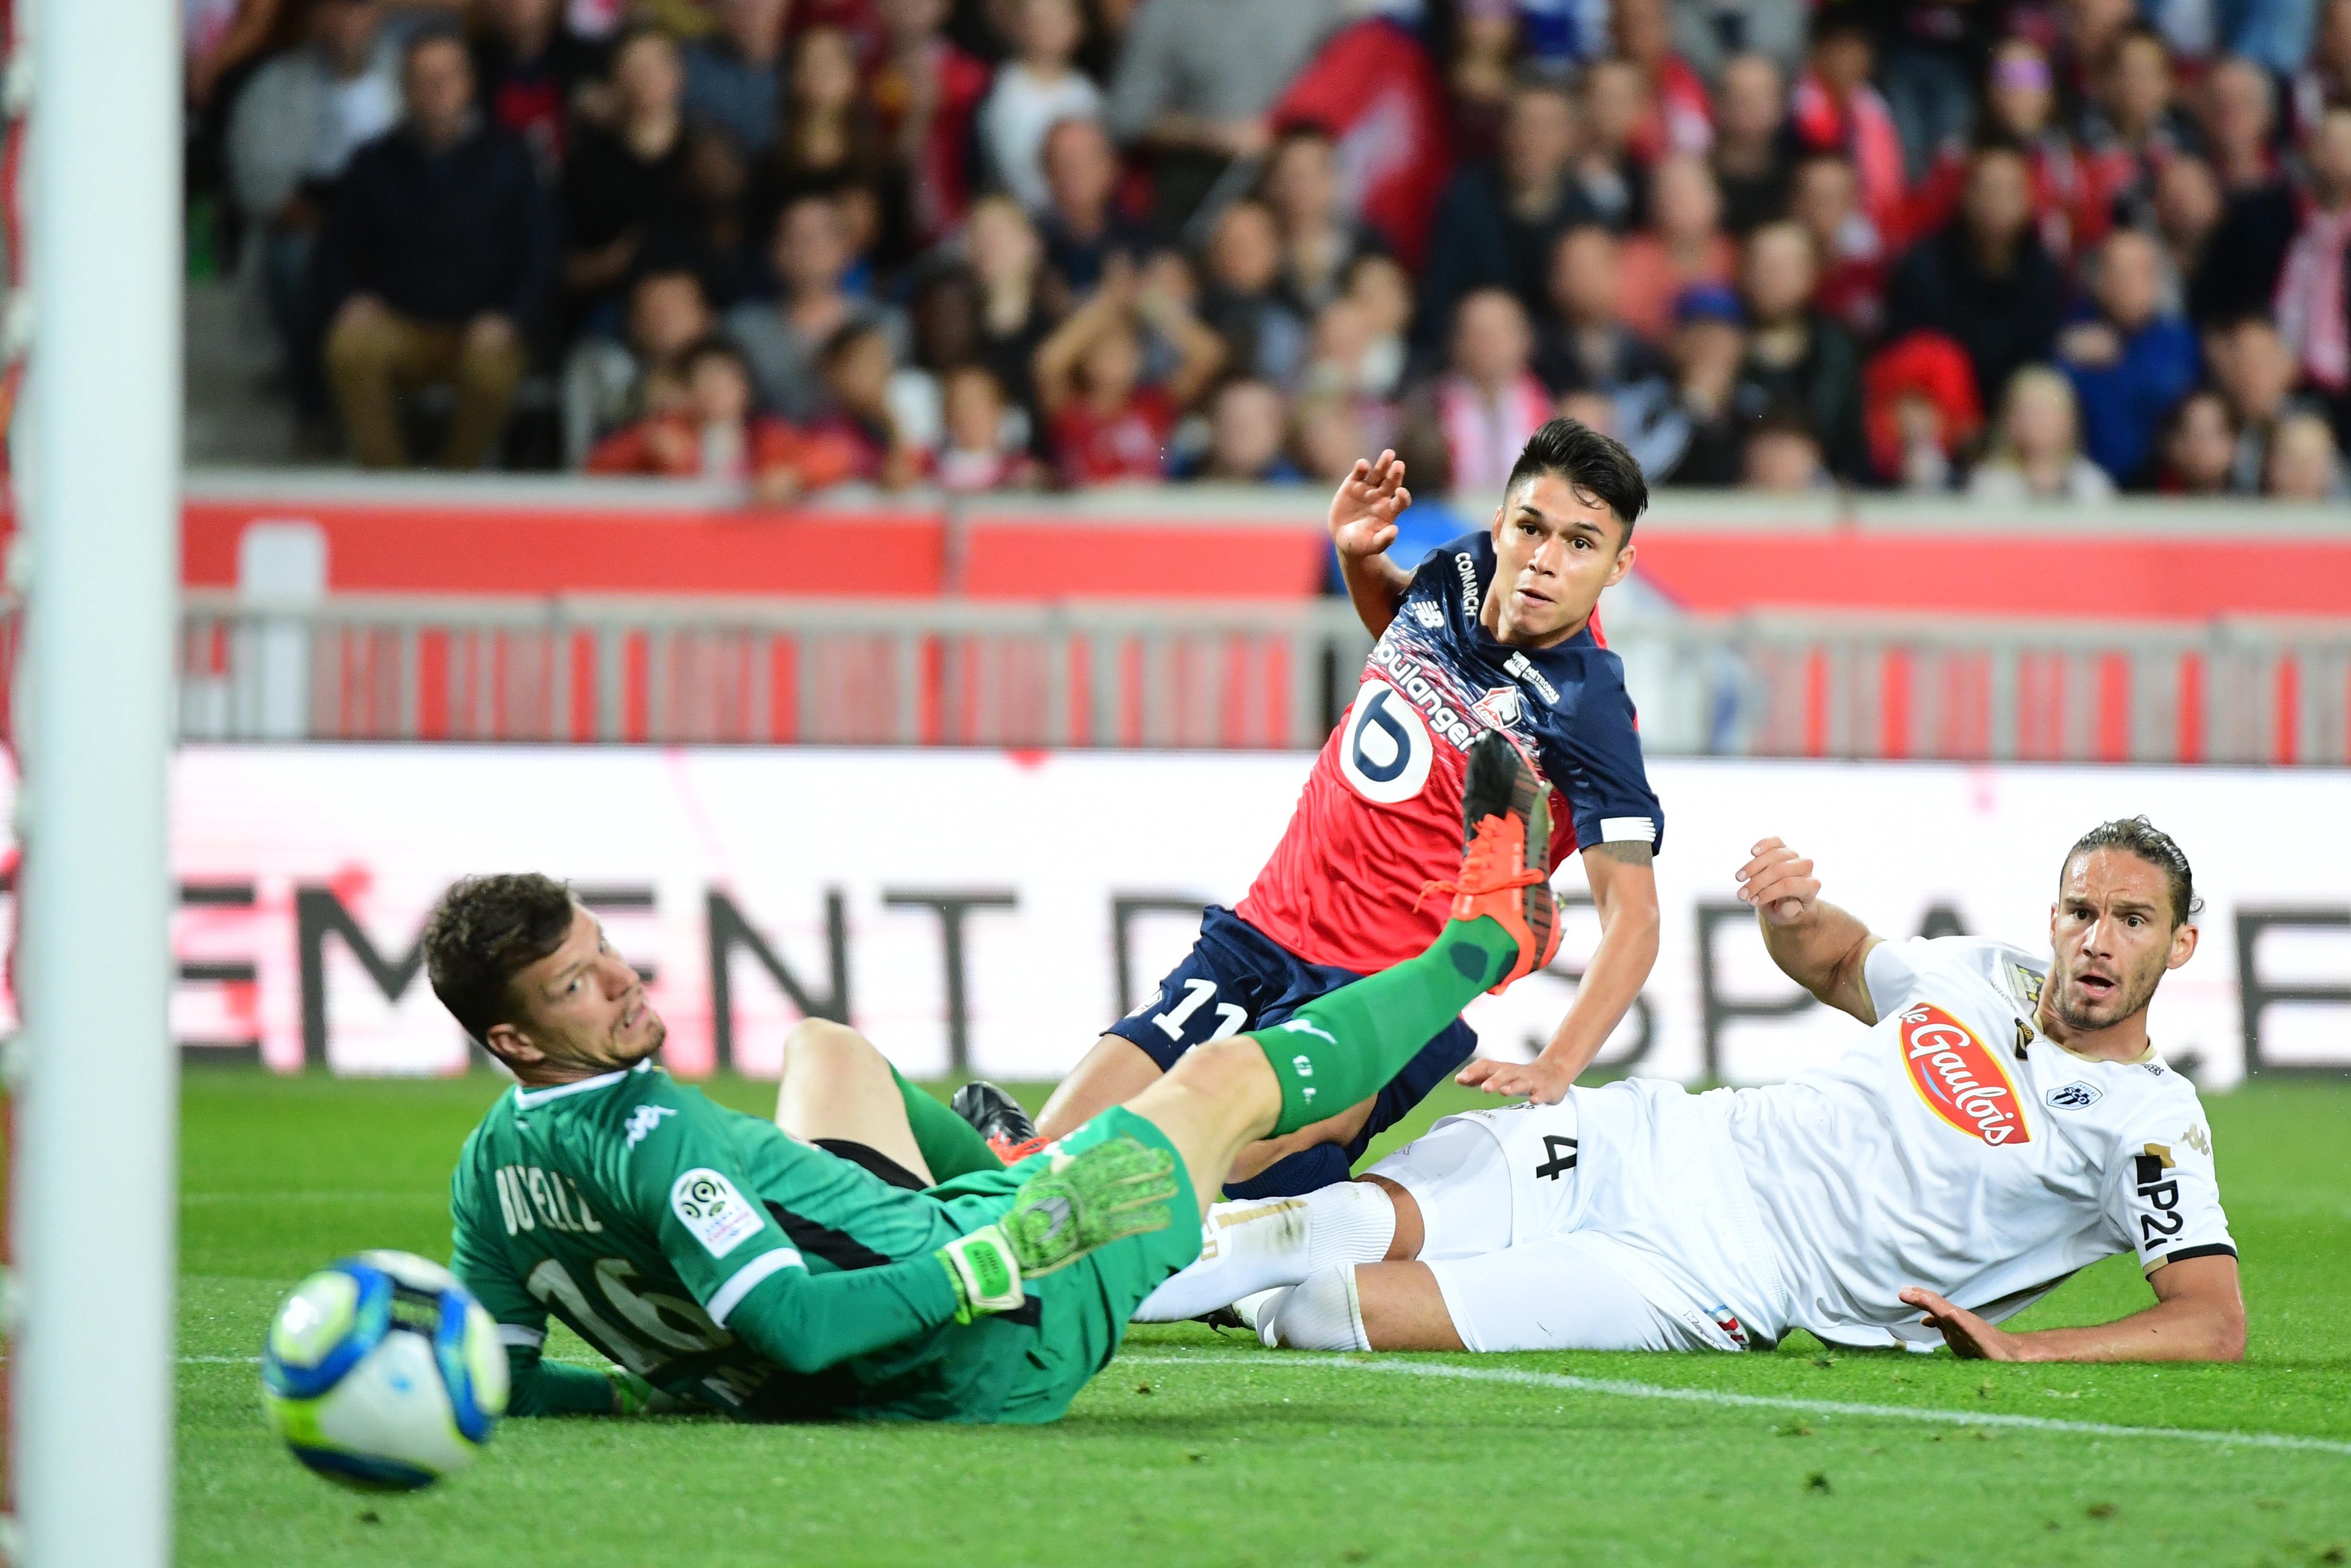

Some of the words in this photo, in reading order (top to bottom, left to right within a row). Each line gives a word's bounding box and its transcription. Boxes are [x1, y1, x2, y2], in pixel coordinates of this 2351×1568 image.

[1455, 552, 1479, 616] COMARCH
[1511, 658, 1526, 673] MEL
[1152, 978, 1249, 1054] 11
[1901, 1006, 1931, 1024] le
[1909, 1023, 2015, 1144] Gaulois
[2063, 1087, 2089, 1104] SCO
[1536, 1134, 1578, 1181] 4
[526, 1257, 736, 1375] 16
